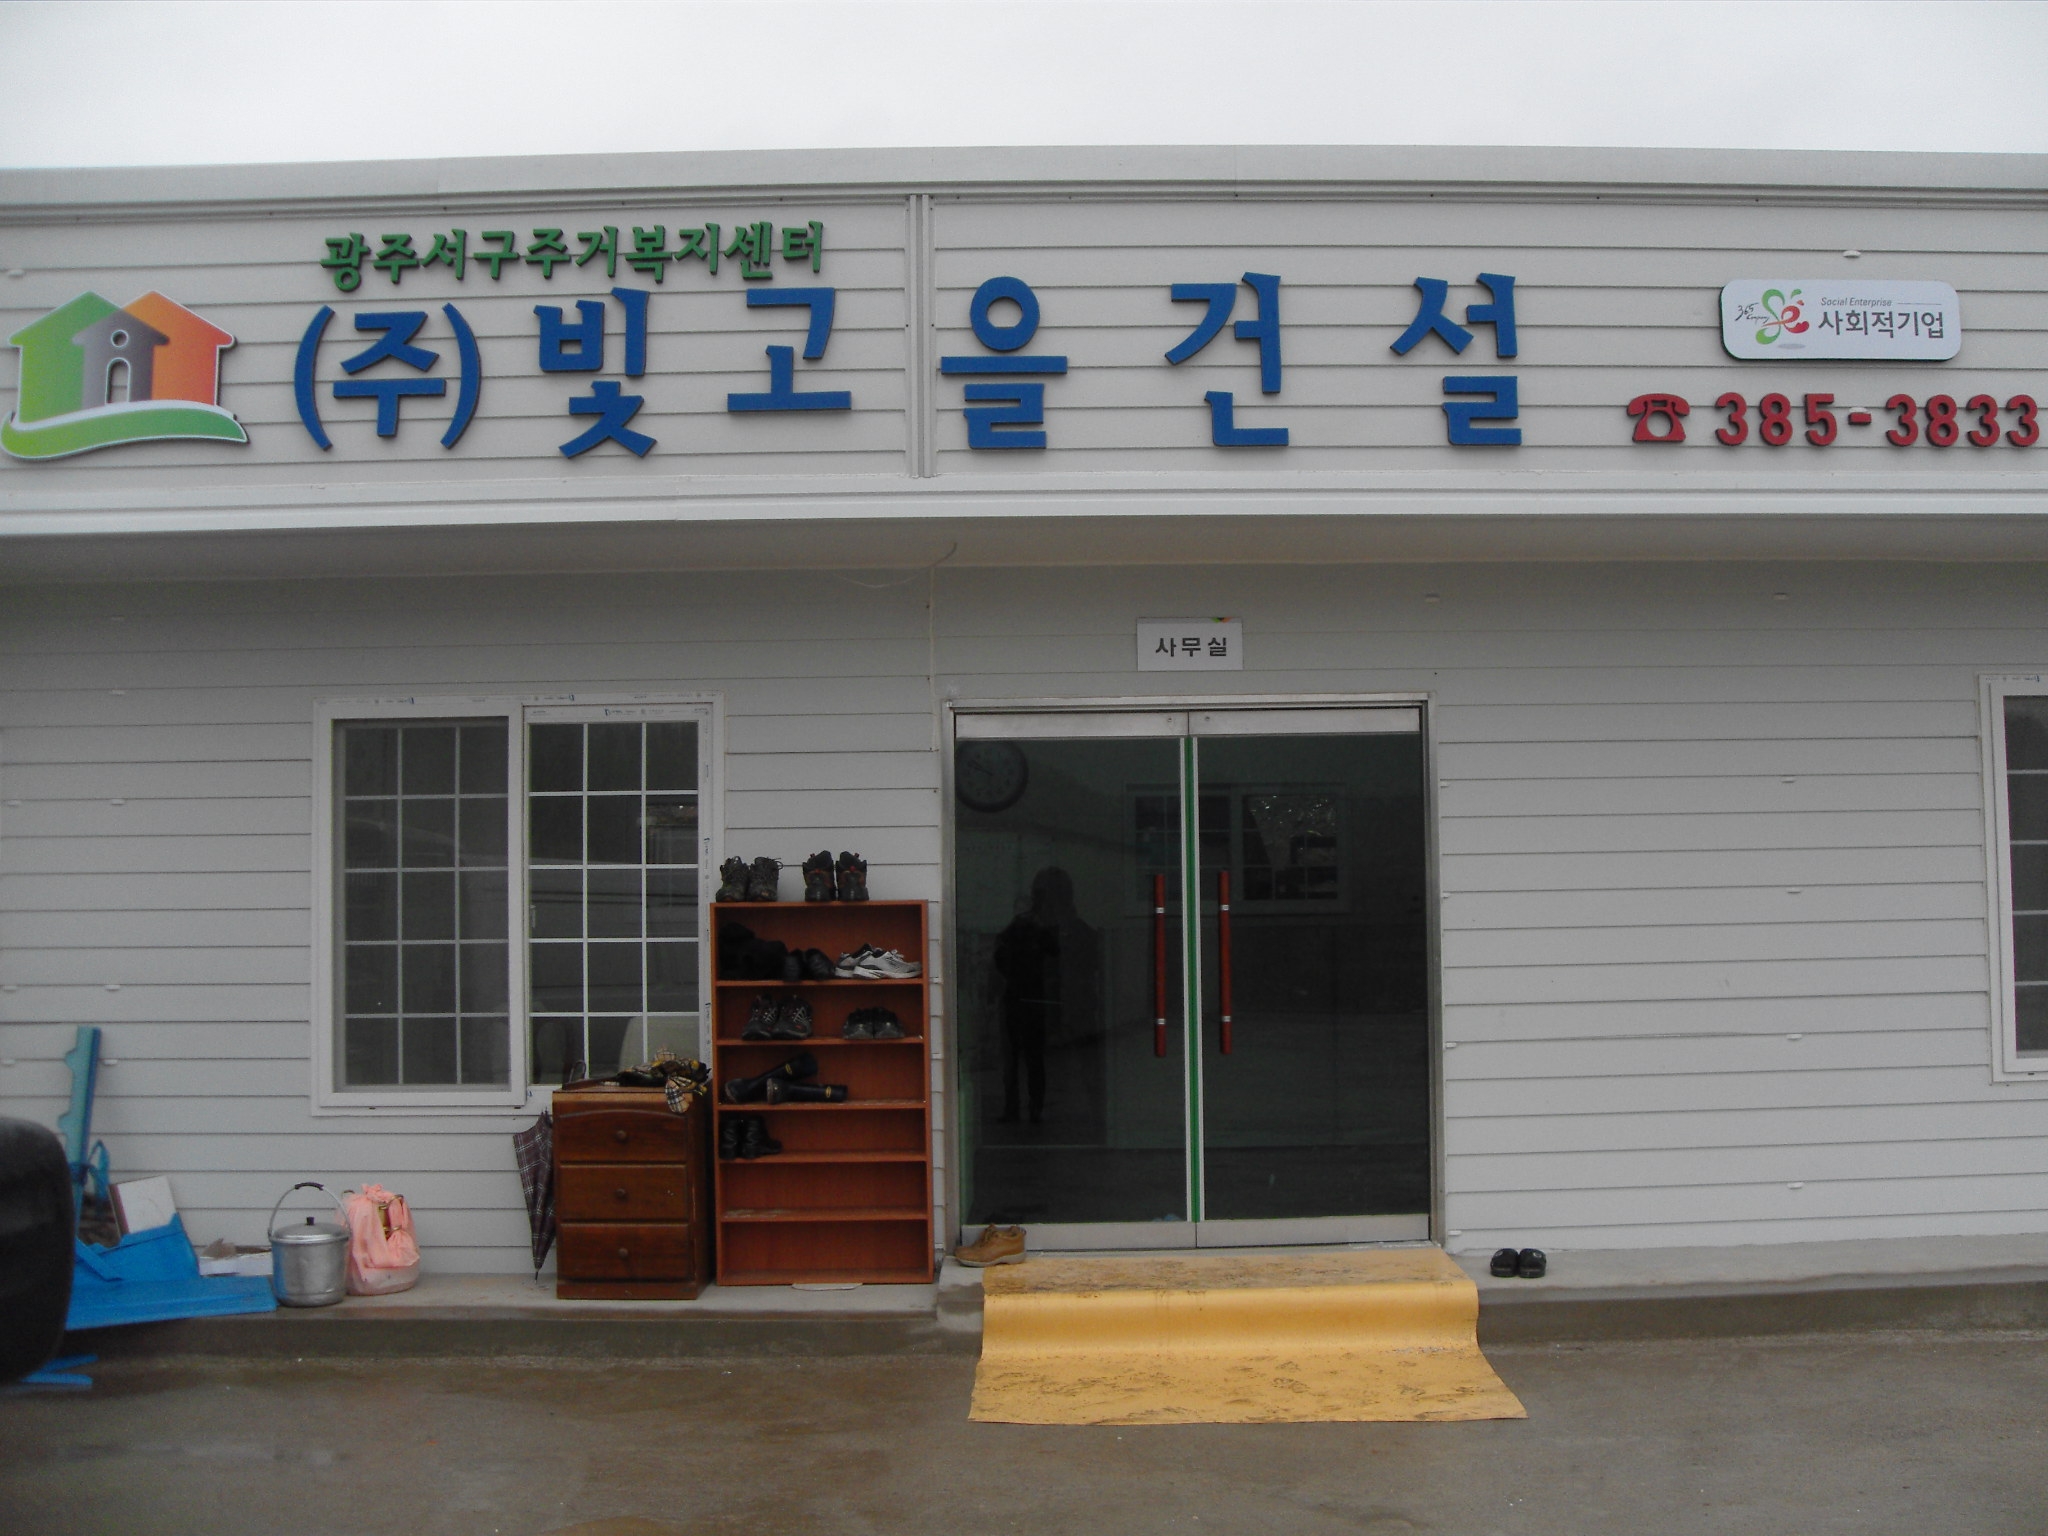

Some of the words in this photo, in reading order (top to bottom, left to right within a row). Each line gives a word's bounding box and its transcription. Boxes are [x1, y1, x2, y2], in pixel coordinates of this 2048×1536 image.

[321, 221, 824, 292] 광주서구주거복지센터
[1821, 297, 1848, 307] Social
[1849, 298, 1892, 308] Enterprise
[1818, 310, 1944, 339] 사회적기업
[1715, 392, 2040, 447] 385-3833
[1155, 637, 1227, 657] 사무실
